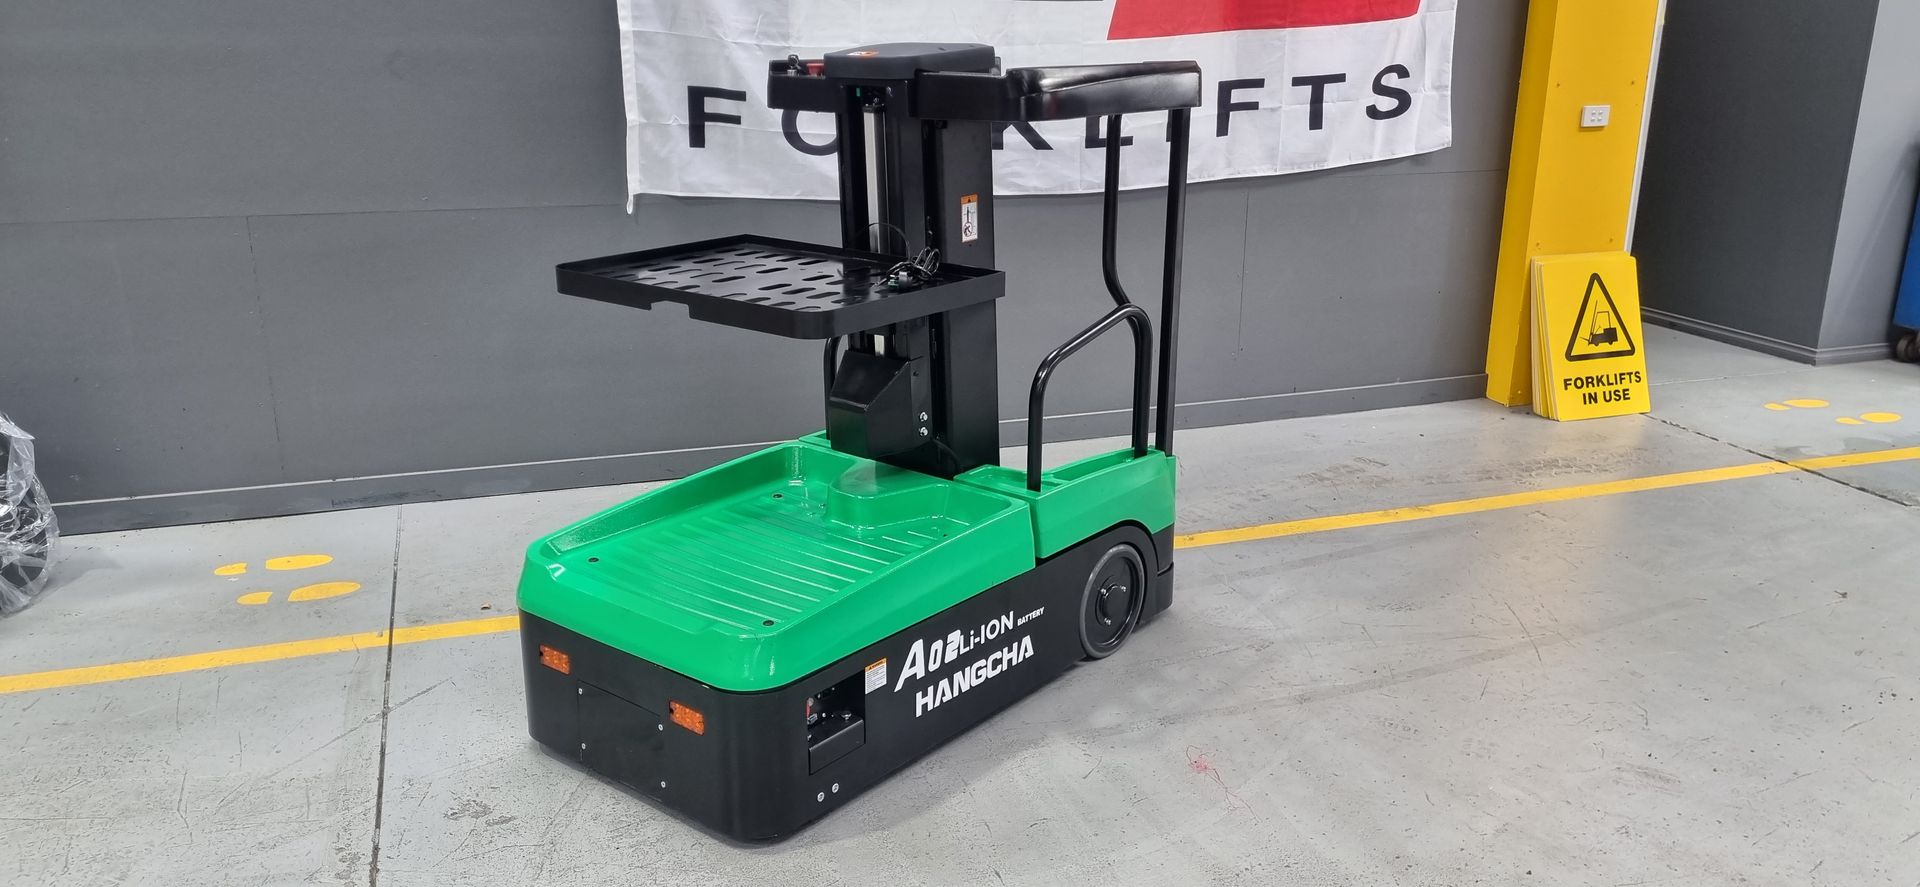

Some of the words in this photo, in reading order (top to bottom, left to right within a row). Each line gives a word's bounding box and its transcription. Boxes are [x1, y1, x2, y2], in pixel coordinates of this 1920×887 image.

[1563, 371, 1642, 391] FORKLIFTS
[1582, 392, 1598, 405] IN
[1602, 388, 1631, 403] USE
[1017, 606, 1045, 627] BATTERY
[915, 634, 1035, 718] HANGCHA
